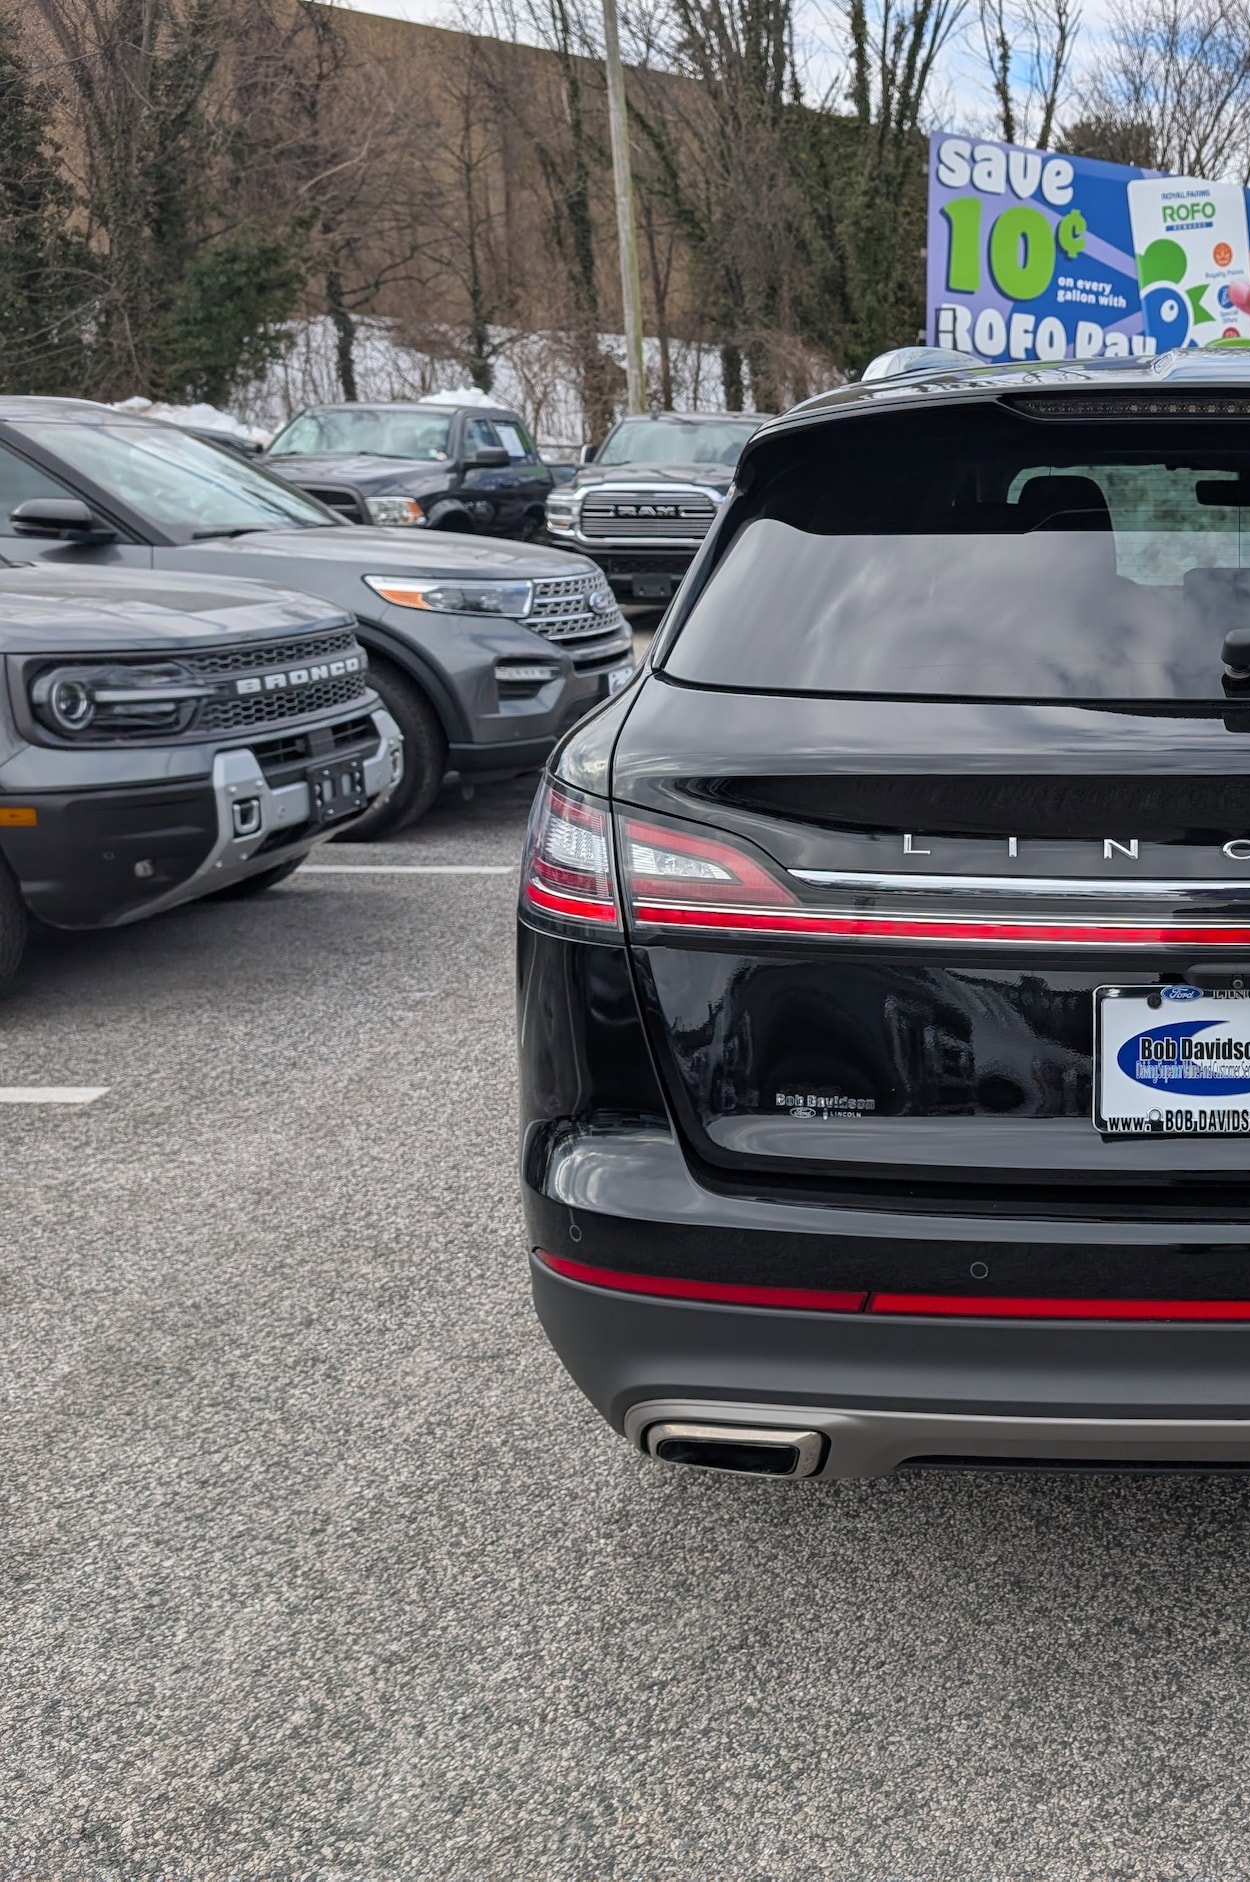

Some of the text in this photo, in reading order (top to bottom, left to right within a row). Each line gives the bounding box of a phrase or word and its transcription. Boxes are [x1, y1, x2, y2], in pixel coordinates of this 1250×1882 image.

[936, 138, 1074, 206] save
[1162, 201, 1216, 223] ROFO
[1058, 276, 1112, 294] on every
[1057, 289, 1127, 309] gallon with
[938, 303, 1067, 360] ROFO
[617, 505, 676, 517] RAM
[237, 657, 359, 695] BRONCO
[1140, 1036, 1177, 1061] Bob
[1213, 1061, 1240, 1079] Customer
[775, 1093, 876, 1110] Bob Davidson
[1165, 1109, 1194, 1132] BOB
